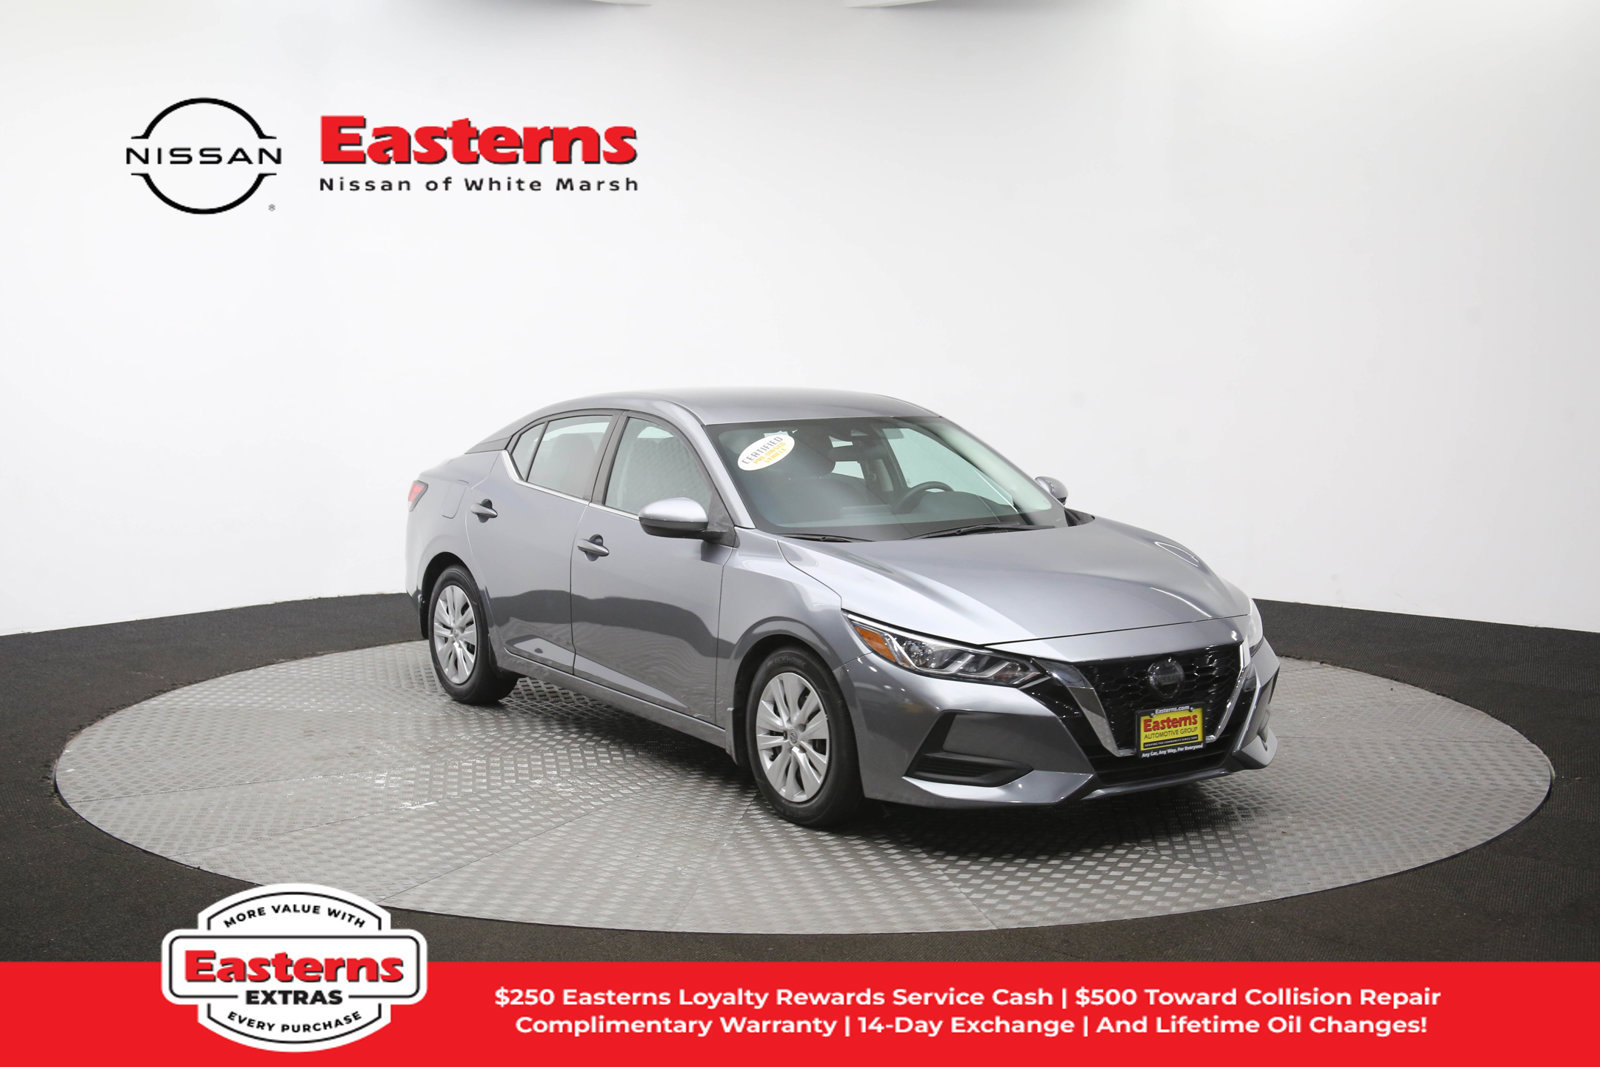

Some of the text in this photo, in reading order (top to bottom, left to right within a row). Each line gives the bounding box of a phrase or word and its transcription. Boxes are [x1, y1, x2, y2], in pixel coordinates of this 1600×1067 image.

[741, 436, 784, 465] CERTIFIED
[1143, 714, 1198, 732] Easterns
[1143, 726, 1198, 740] AUTOMOTIVE GROUP
